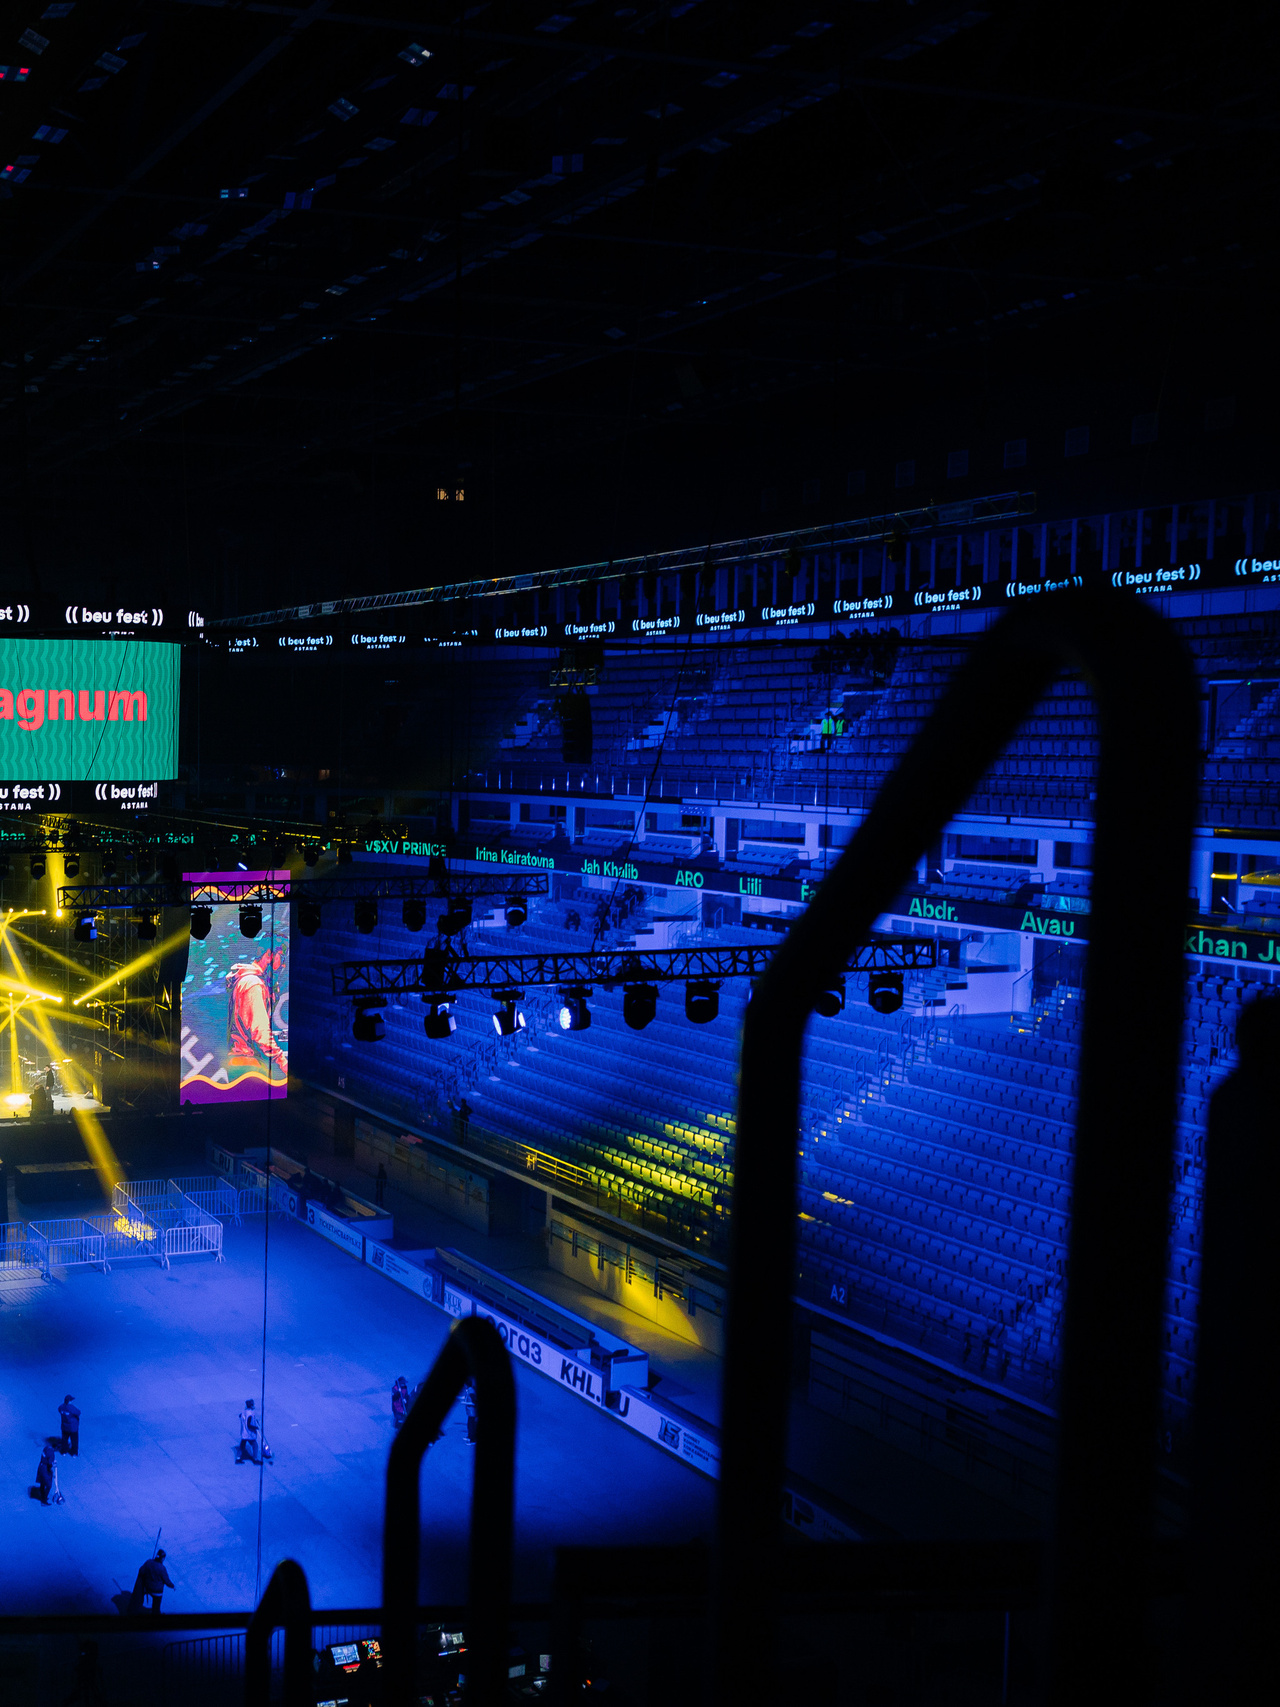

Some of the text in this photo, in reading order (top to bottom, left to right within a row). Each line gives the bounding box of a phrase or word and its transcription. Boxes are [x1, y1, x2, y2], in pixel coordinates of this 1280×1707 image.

[1126, 567, 1185, 585] beu fest
[925, 588, 970, 604] beu fest
[1018, 581, 1041, 596] beu
[770, 604, 806, 618] beu fest
[843, 598, 882, 612] beu fest
[82, 606, 148, 625] beu fest
[704, 611, 737, 624] beu fest
[573, 622, 608, 634] beu fest
[640, 618, 672, 630] beu fest
[360, 634, 397, 644] beu fest
[504, 627, 539, 638] beu fest
[288, 636, 324, 646] beu fest
[12, 784, 44, 800] fest
[111, 782, 154, 799] beu fest
[475, 846, 555, 870] Irina Kairatovna
[581, 858, 639, 880] Jah Khalib
[675, 869, 704, 889] ARO
[908, 897, 959, 922] Abdr.
[830, 1284, 845, 1305] A2
